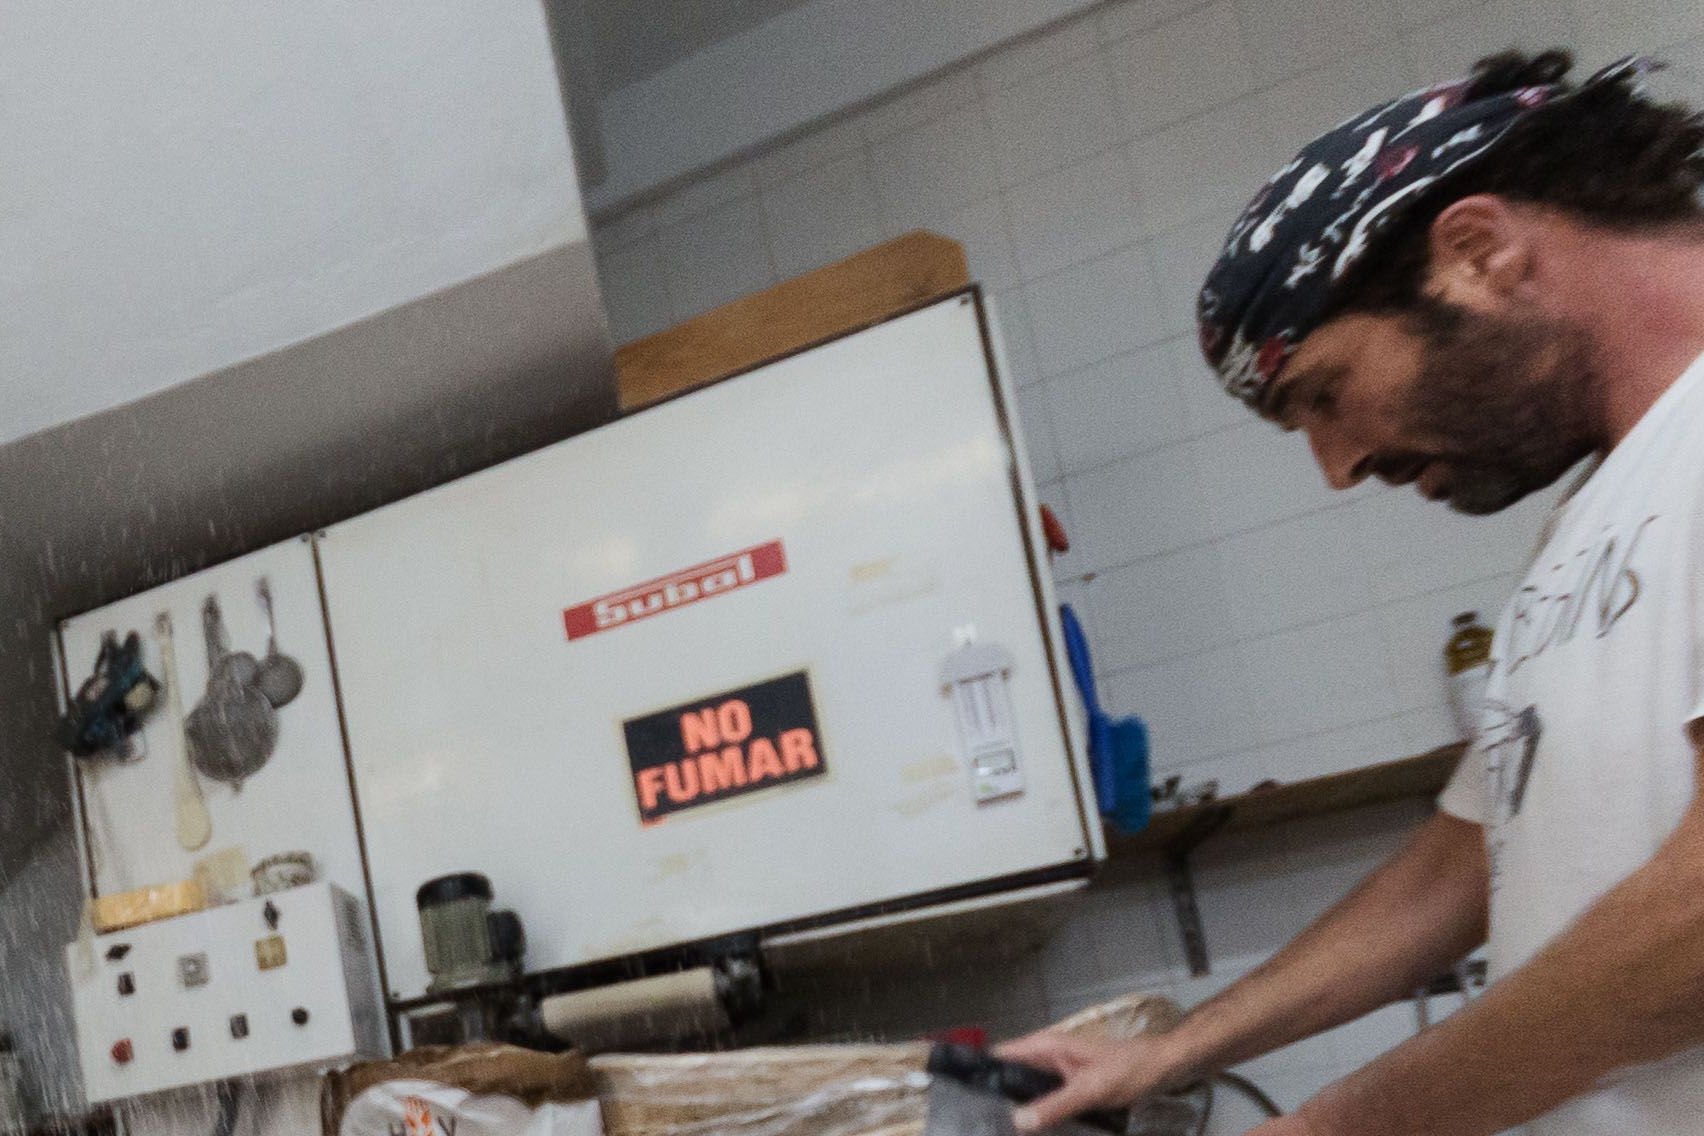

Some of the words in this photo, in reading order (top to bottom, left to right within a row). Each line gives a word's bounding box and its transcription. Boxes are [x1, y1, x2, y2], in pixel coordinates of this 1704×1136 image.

[593, 552, 756, 628] Subal
[680, 699, 753, 753] NO
[637, 727, 819, 809] FUMAR
